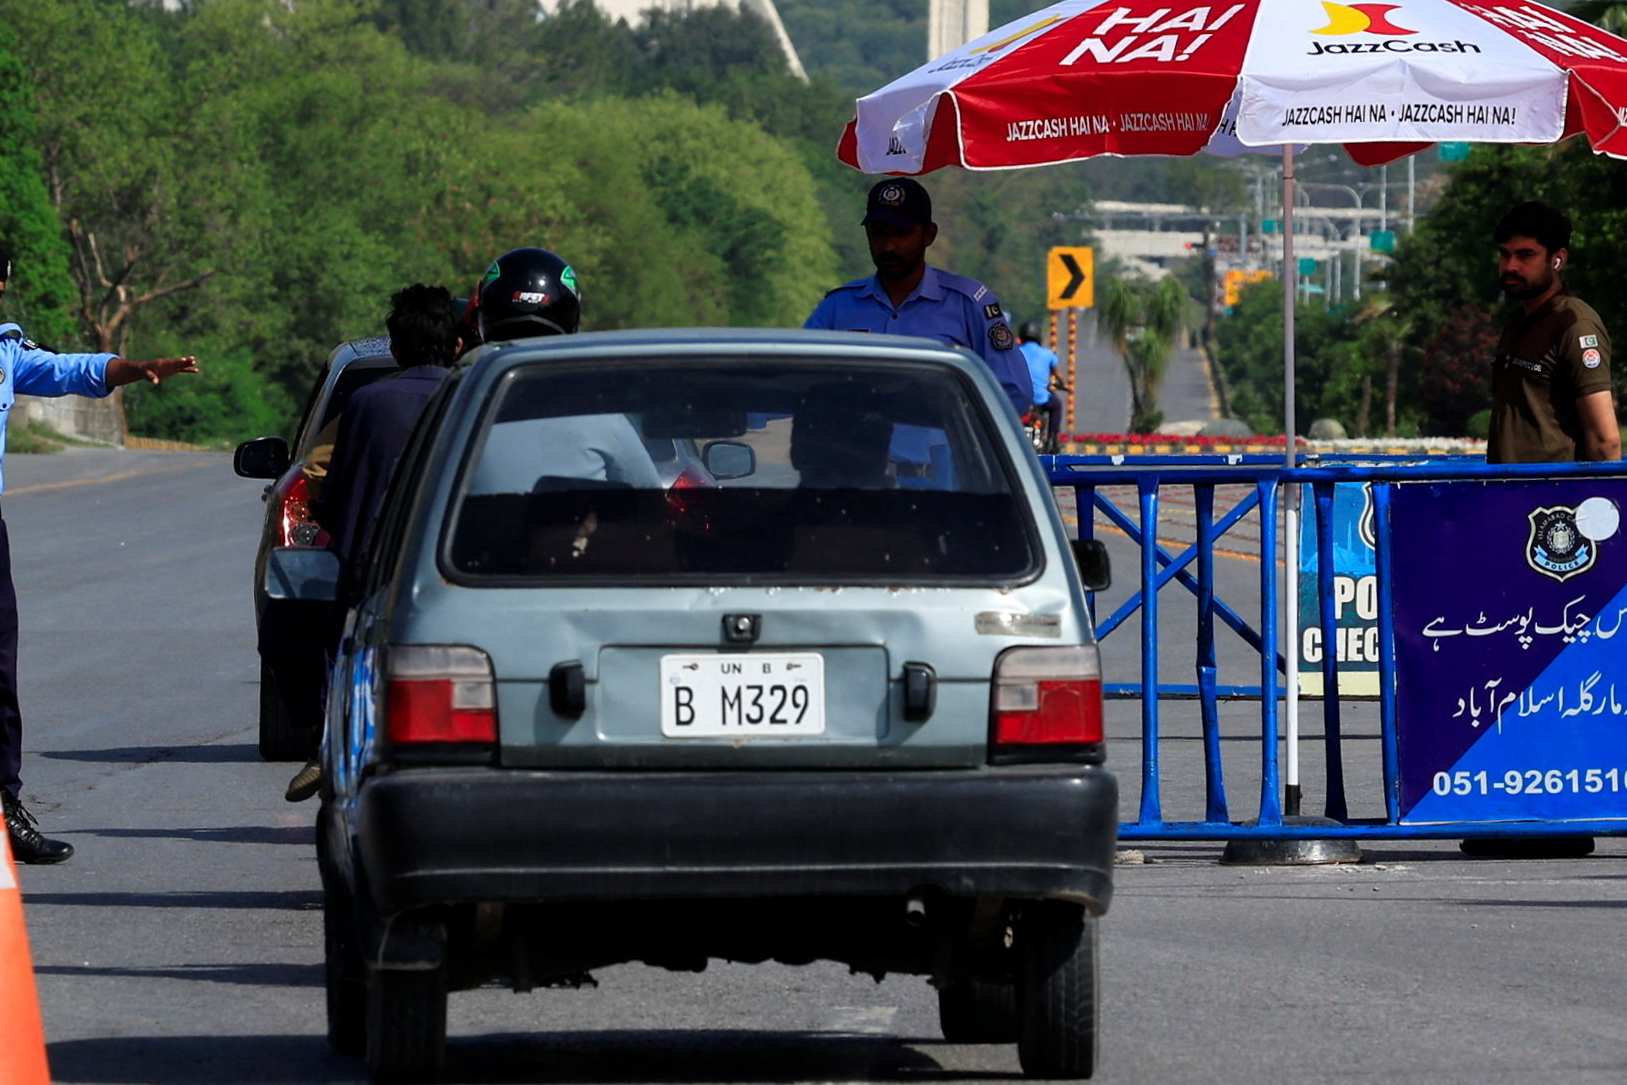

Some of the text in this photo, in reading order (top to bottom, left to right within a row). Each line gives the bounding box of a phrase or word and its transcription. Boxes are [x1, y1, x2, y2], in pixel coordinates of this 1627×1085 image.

[1093, 4, 1246, 35] HAI
[1059, 33, 1214, 66] NA!
[1306, 40, 1481, 56] JazzCash
[1005, 118, 1067, 142] JAZZCASH
[1070, 117, 1091, 136] HAI
[1091, 115, 1109, 133] NA
[1119, 113, 1175, 133] JAZZCASH
[1176, 112, 1195, 131] HAI
[1281, 104, 1516, 127] JAZZCASH HAI NA JAZZCASH HAI NA!
[1545, 560, 1579, 571] POLICE
[1422, 615, 1463, 652] ہے
[1465, 606, 1533, 650] پوسٹ
[720, 662, 772, 675] UN B
[674, 684, 810, 726] B M329
[1432, 767, 1627, 796] 051-926151
